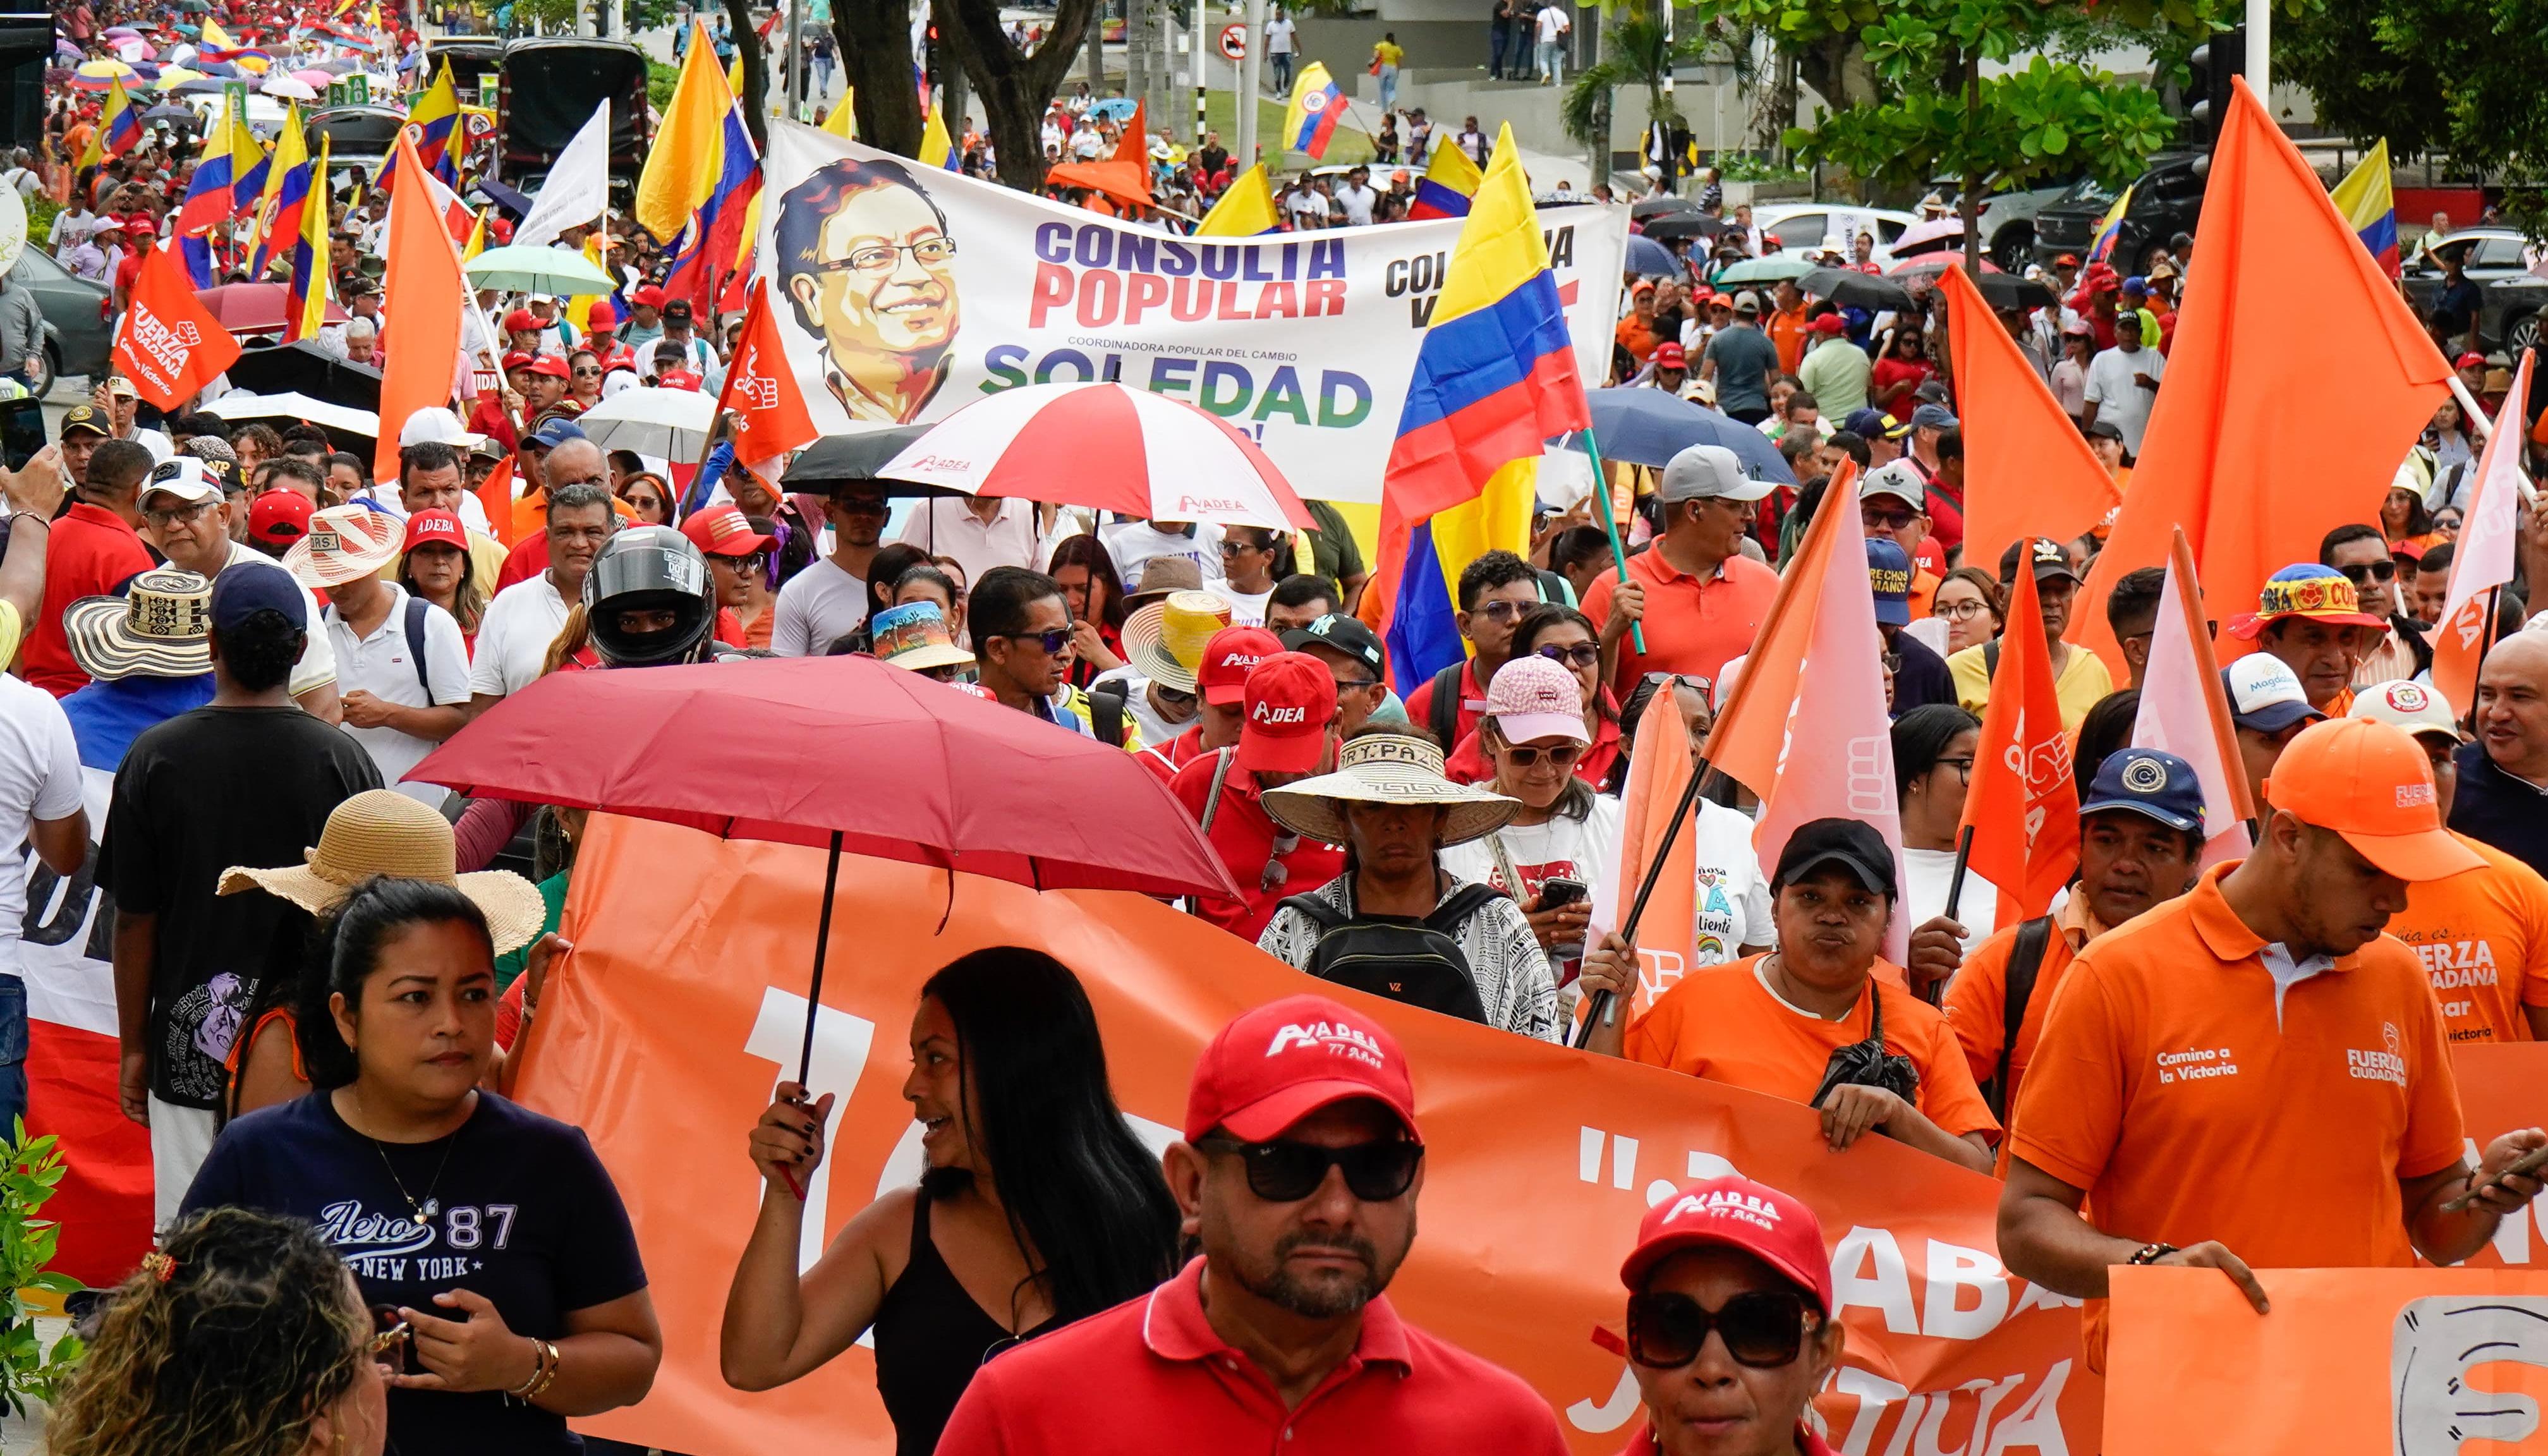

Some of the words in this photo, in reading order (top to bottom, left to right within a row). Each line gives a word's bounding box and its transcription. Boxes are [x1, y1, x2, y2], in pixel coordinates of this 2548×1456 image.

[1034, 222, 1347, 281] CONSULTA
[1028, 260, 1347, 328] POPULAR
[1068, 337, 1165, 353] COORDINADORA
[1168, 344, 1224, 358] POPULAR
[1227, 349, 1249, 359] DEL
[1251, 351, 1297, 362] CAMBIO
[140, 363, 172, 396] Victoria
[474, 373, 499, 391] IDA
[417, 518, 455, 535] ADEBA
[668, 561, 685, 578] DOT
[1252, 700, 1305, 725] ADEA
[1329, 1043, 1345, 1055] 77
[2156, 1046, 2215, 1067] Camino
[2219, 1047, 2231, 1059] a
[2347, 1048, 2406, 1074] FUERZA
[2159, 1070, 2175, 1084] la
[2176, 1062, 2238, 1081] Victoria
[315, 1199, 423, 1248] Aero
[1710, 1207, 1730, 1218] 77
[361, 1257, 408, 1281] NEW
[416, 1256, 469, 1282] YORK
[1566, 1357, 2074, 1456] JTICIA
